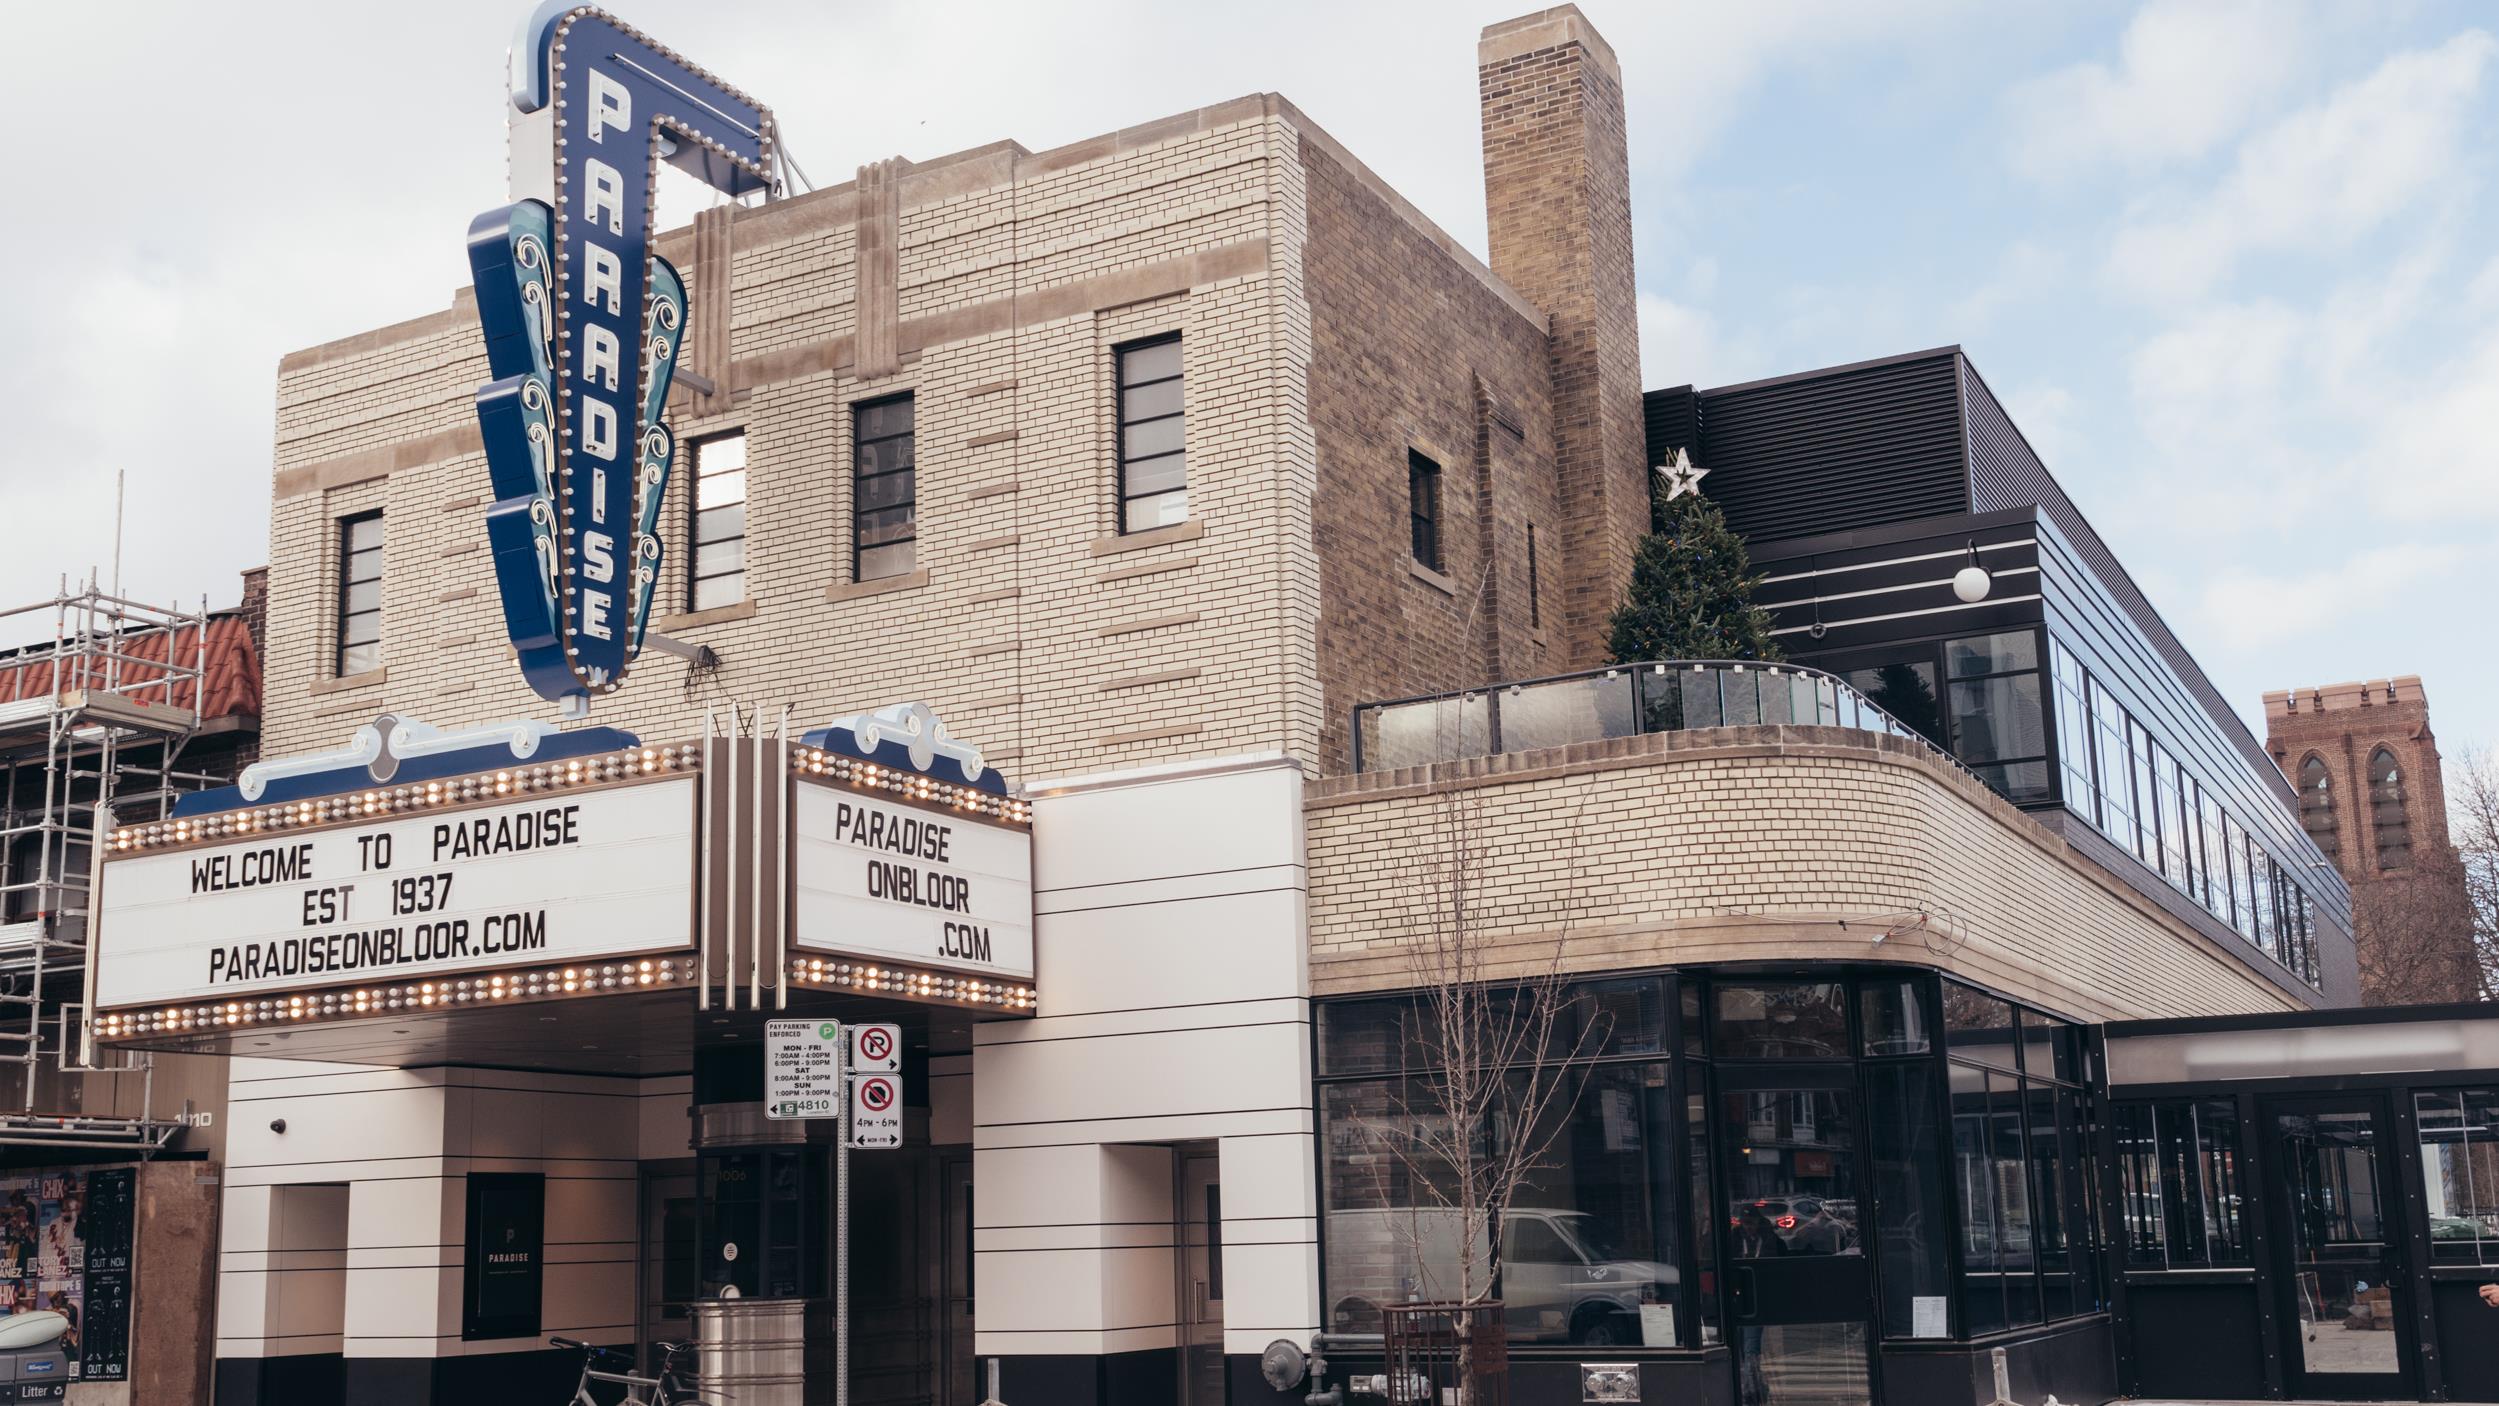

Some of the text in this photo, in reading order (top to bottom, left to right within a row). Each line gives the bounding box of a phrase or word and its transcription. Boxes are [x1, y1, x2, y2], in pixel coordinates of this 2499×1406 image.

[582, 67, 631, 641] PARADISE
[836, 803, 951, 863] PARADISE
[191, 806, 580, 894] WELCOME TO PARADISE
[868, 860, 970, 913] ONBLOOR
[303, 873, 453, 926] EST 1937
[209, 910, 546, 983] PARADISEONBLOOR.COM
[939, 922, 991, 962] .COM
[798, 1100, 829, 1110] 4810
[42, 1178, 64, 1200] CHIX
[0, 1257, 18, 1268] ORY
[91, 1256, 126, 1268] OUT NOW
[488, 1252, 529, 1263] PARADISE
[0, 1267, 22, 1278] ANEZ
[0, 1285, 15, 1305] HIX
[87, 1363, 121, 1374] OUT NOW
[22, 1386, 48, 1398] Litter
